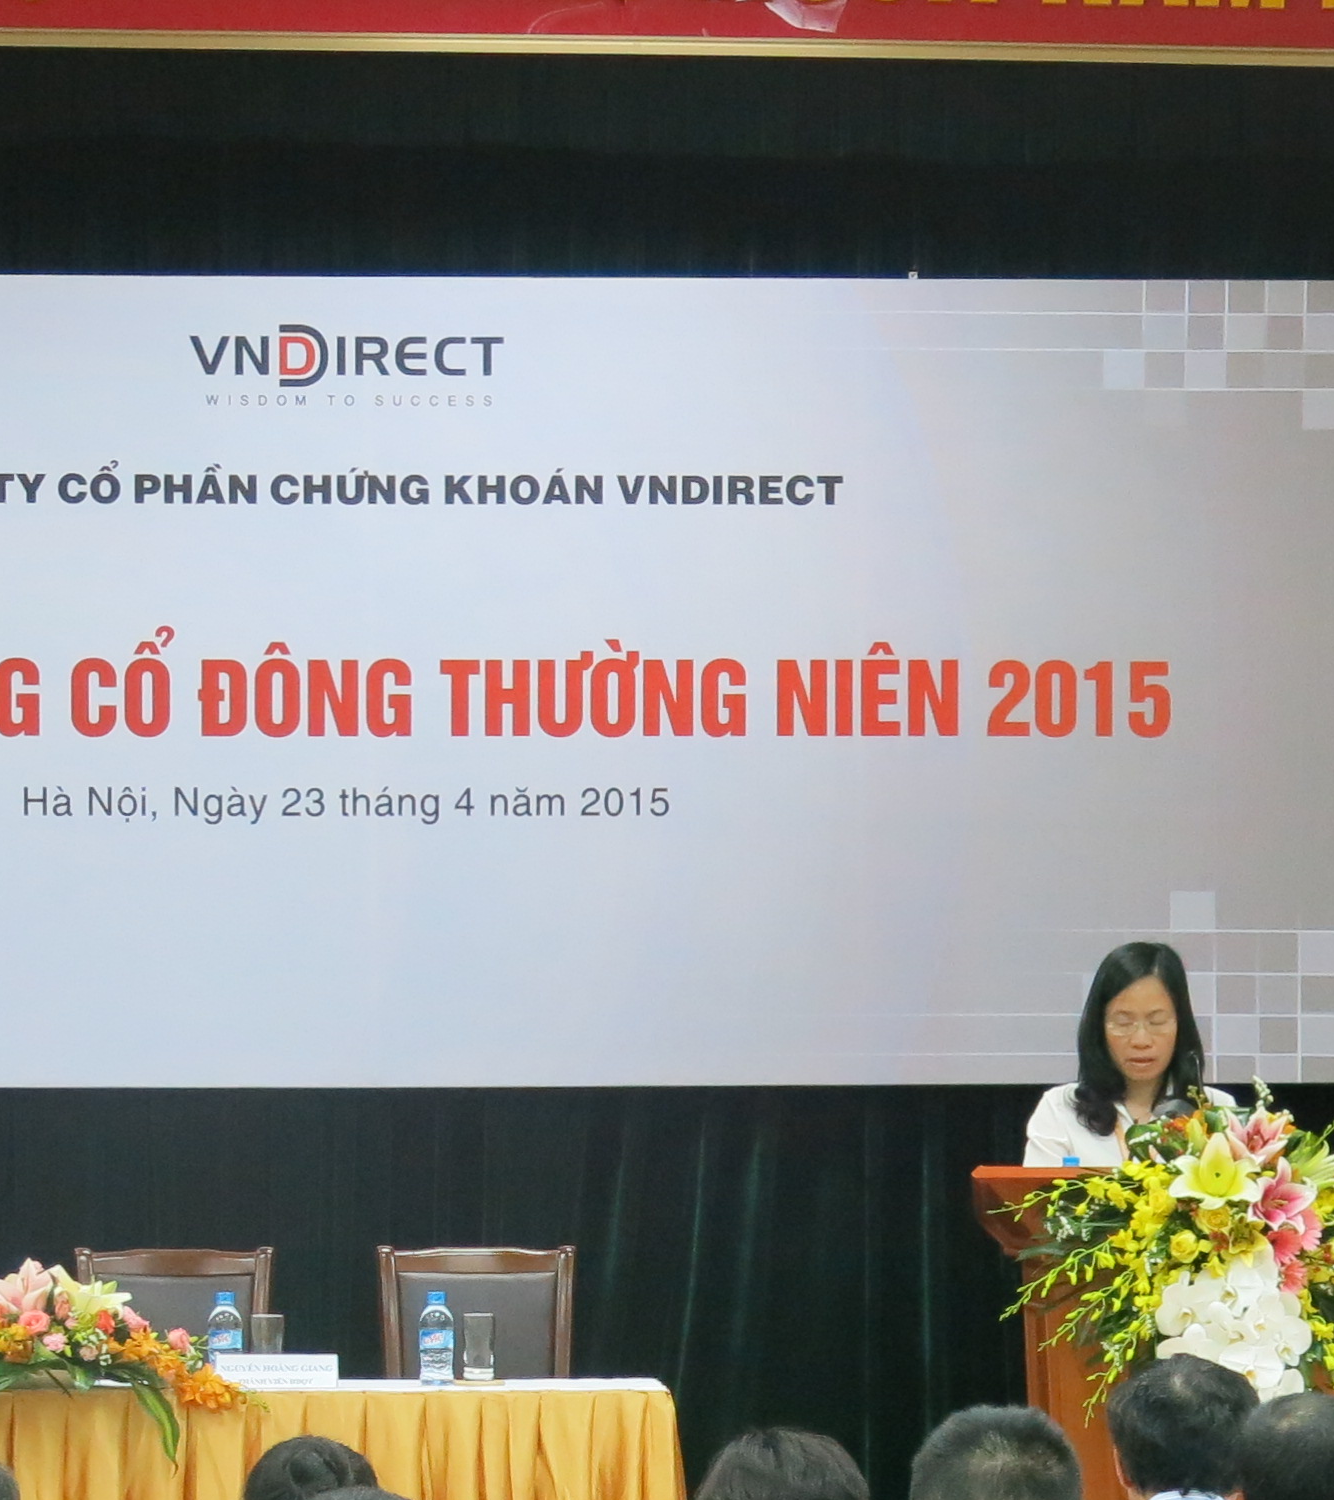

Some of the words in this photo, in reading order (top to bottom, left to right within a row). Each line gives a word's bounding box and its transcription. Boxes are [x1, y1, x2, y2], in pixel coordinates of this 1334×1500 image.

[205, 394, 307, 407] WISDOM
[327, 394, 356, 407] TO
[374, 394, 494, 407] SUCCESS
[58, 460, 120, 504] CỔ
[134, 464, 257, 504] PHẦN
[271, 466, 430, 505] CHỨNG
[444, 467, 604, 505] KHOÁN
[617, 474, 843, 505] VNDIRECT
[73, 627, 176, 737] CỔ
[200, 643, 411, 737] ĐÔNG
[442, 640, 746, 738] THƯỜNG
[778, 642, 958, 737] NIÊN
[987, 660, 1171, 738] 2015
[22, 785, 74, 817] Hà
[88, 786, 160, 824] Nội,
[174, 786, 268, 825] Ngày
[281, 787, 326, 817] 23
[338, 786, 440, 825] tháng
[454, 787, 475, 817] 4
[490, 787, 566, 817] năm
[580, 787, 670, 817] 2015
